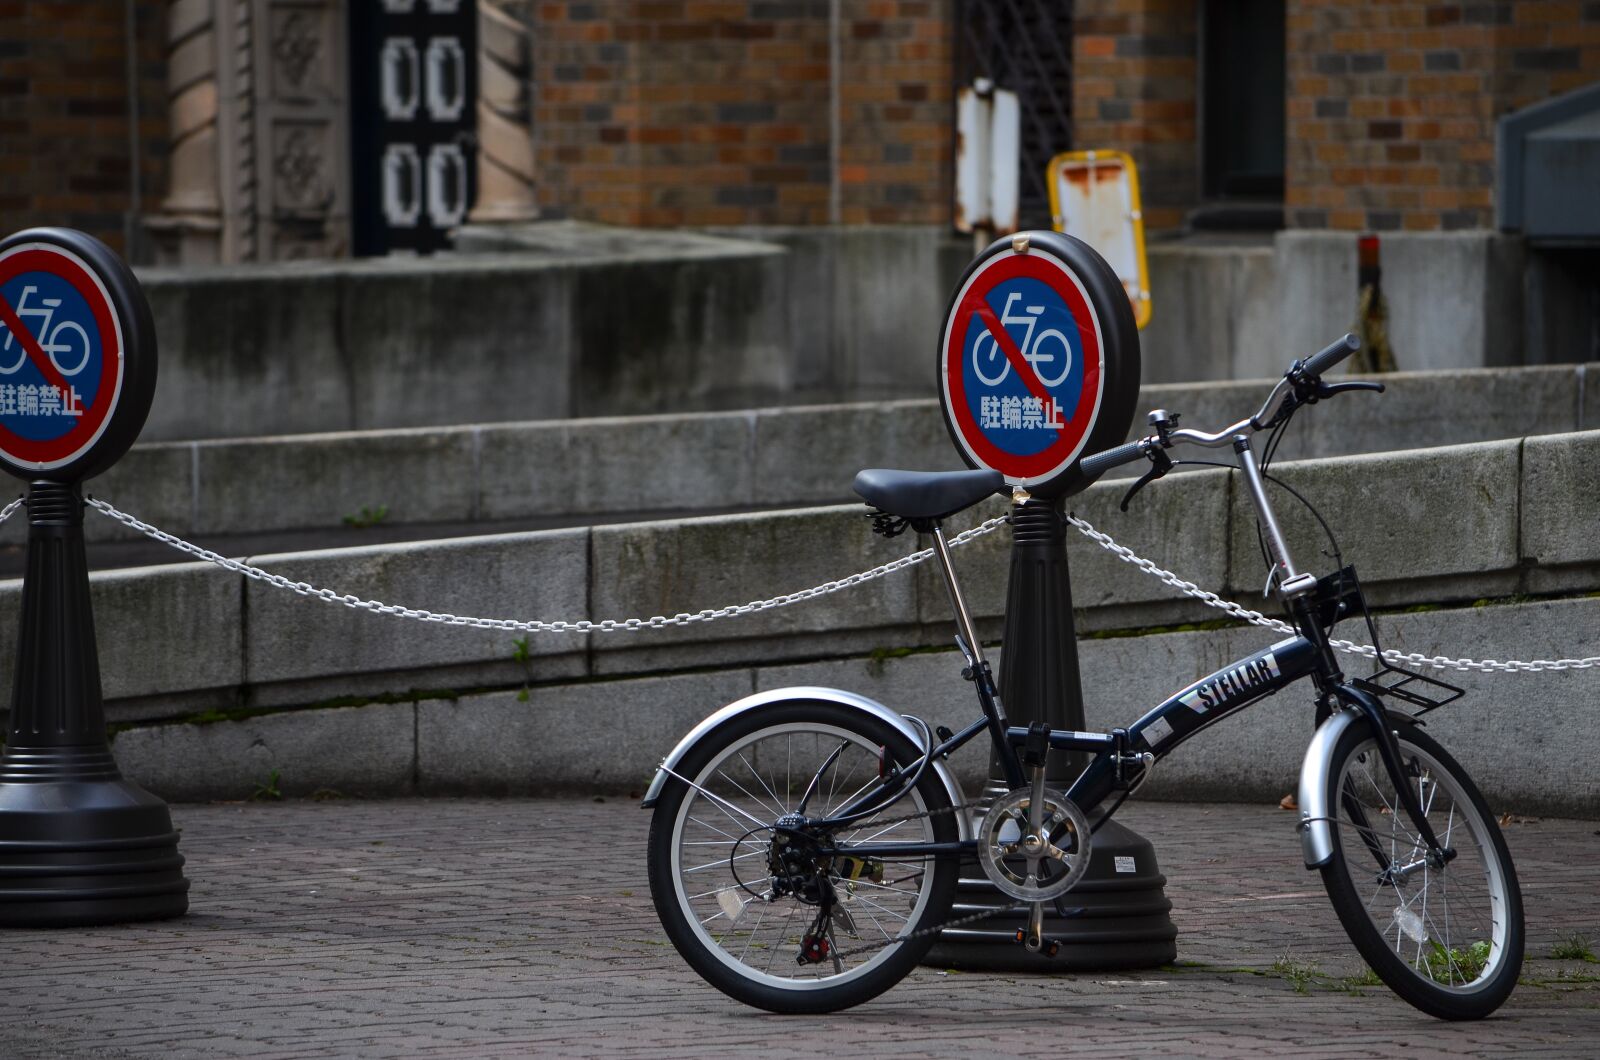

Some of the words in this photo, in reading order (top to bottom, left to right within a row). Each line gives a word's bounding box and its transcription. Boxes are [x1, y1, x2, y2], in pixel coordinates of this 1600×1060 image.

[0, 384, 83, 416] 駐輪禁止
[980, 395, 1064, 429] 駐輪禁止
[1197, 655, 1276, 710] STELLAR
